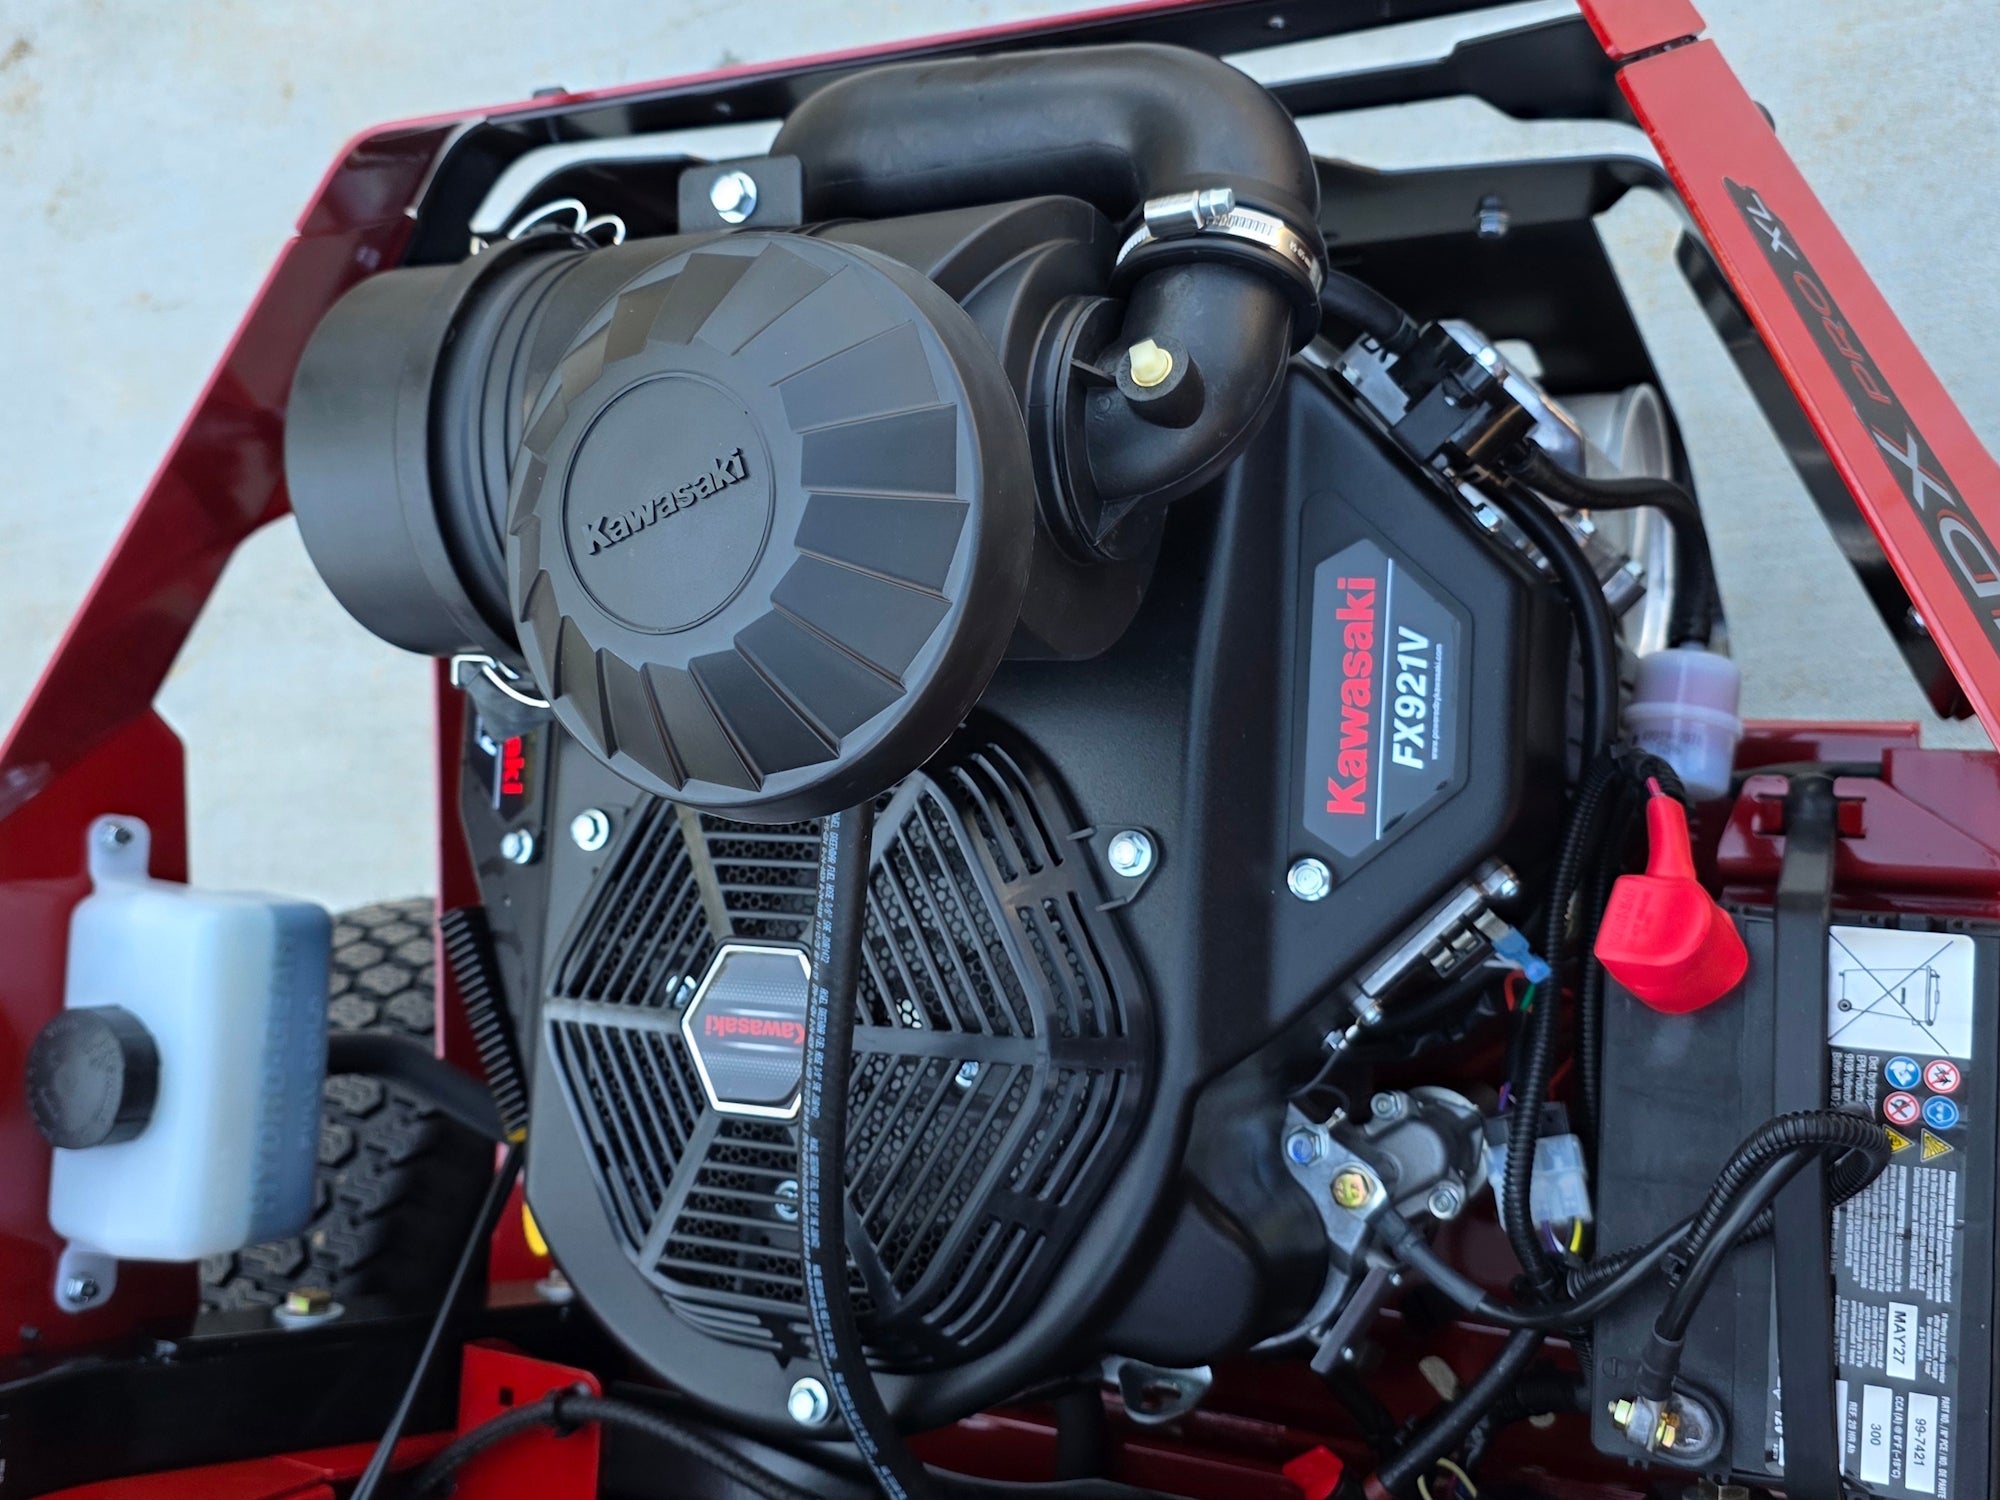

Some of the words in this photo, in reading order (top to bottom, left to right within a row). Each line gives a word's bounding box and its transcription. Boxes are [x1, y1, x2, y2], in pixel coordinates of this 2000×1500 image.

[1745, 191, 1800, 263] XL
[1792, 270, 1891, 412] PRO
[582, 447, 749, 555] Kawasaki
[1872, 421, 2000, 642] DX
[1326, 577, 1376, 815] Kawasaki
[1392, 626, 1429, 770] FX921V
[1893, 1311, 1906, 1364] MAY'27
[1895, 1396, 1904, 1411] CCA
[1941, 1396, 1950, 1412] PART
[1848, 1419, 1857, 1428] 20
[1893, 1413, 1903, 1424] (A)
[1847, 1430, 1856, 1442] HR
[1870, 1423, 1881, 1446] 300
[1914, 1418, 1926, 1466] 99-7421
[1939, 1438, 1948, 1452] PCE
[1847, 1443, 1856, 1453] Ah
[1938, 1469, 1947, 1478] DE
[1937, 1478, 1946, 1499] PARTE
